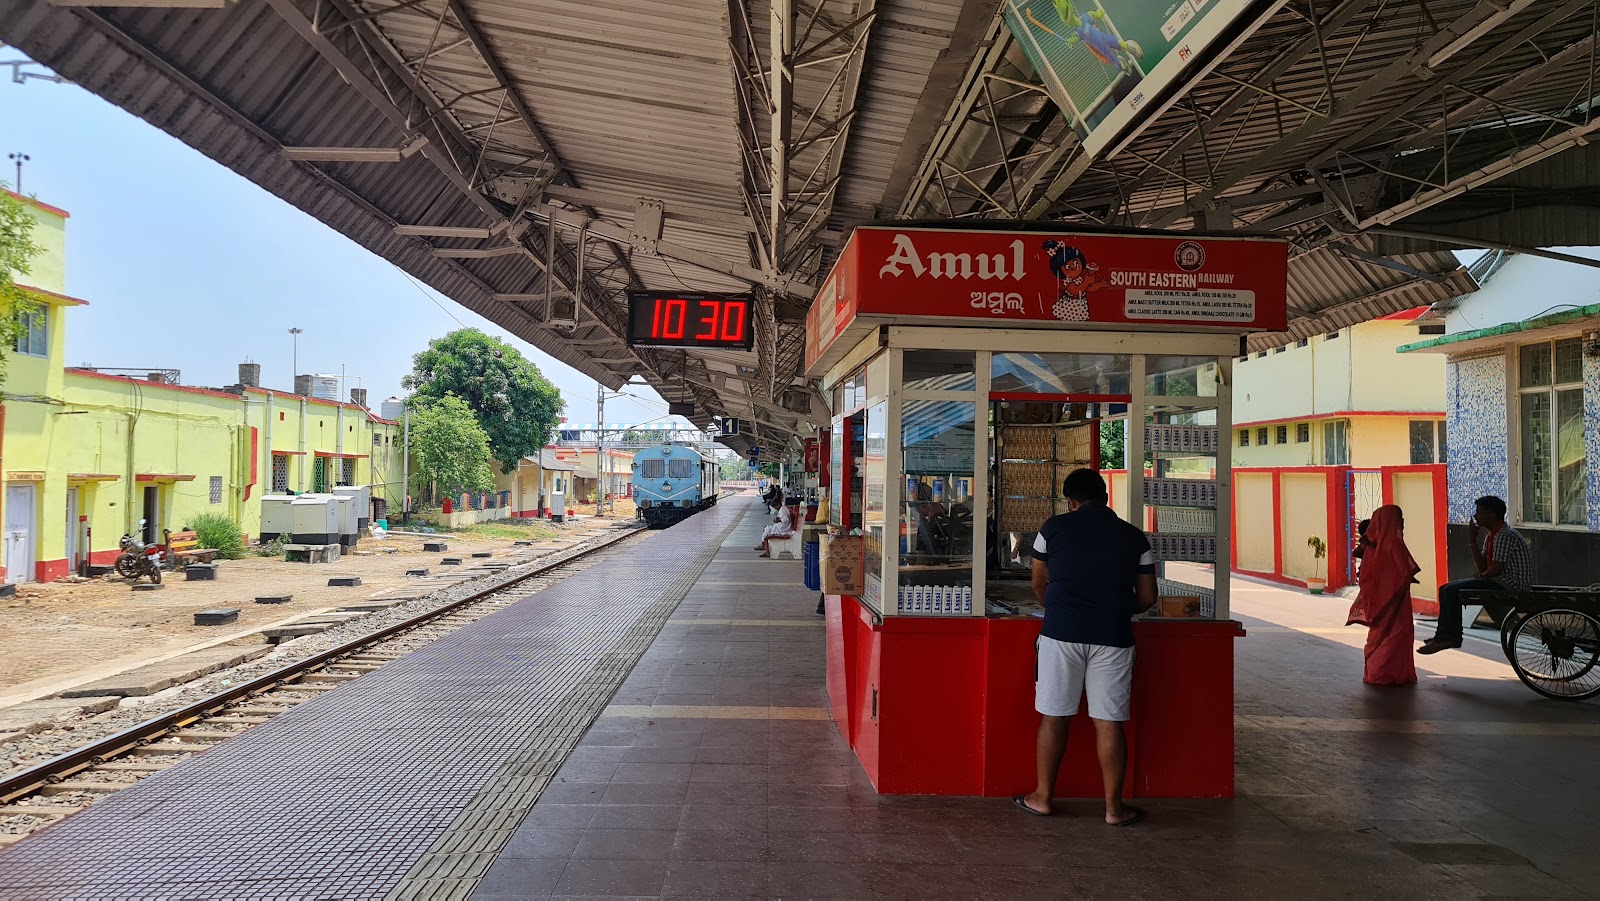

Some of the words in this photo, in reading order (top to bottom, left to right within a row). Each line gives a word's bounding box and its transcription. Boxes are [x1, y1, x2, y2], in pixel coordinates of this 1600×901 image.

[879, 234, 1026, 281] Amul
[1110, 271, 1146, 286] SOUTH
[1148, 272, 1197, 288] EASTERN
[1198, 273, 1234, 284] RAILWAY
[970, 292, 1026, 314] ଅମୁଲ୍
[652, 299, 687, 339] 10
[696, 301, 745, 341] 30
[726, 418, 733, 433] 1
